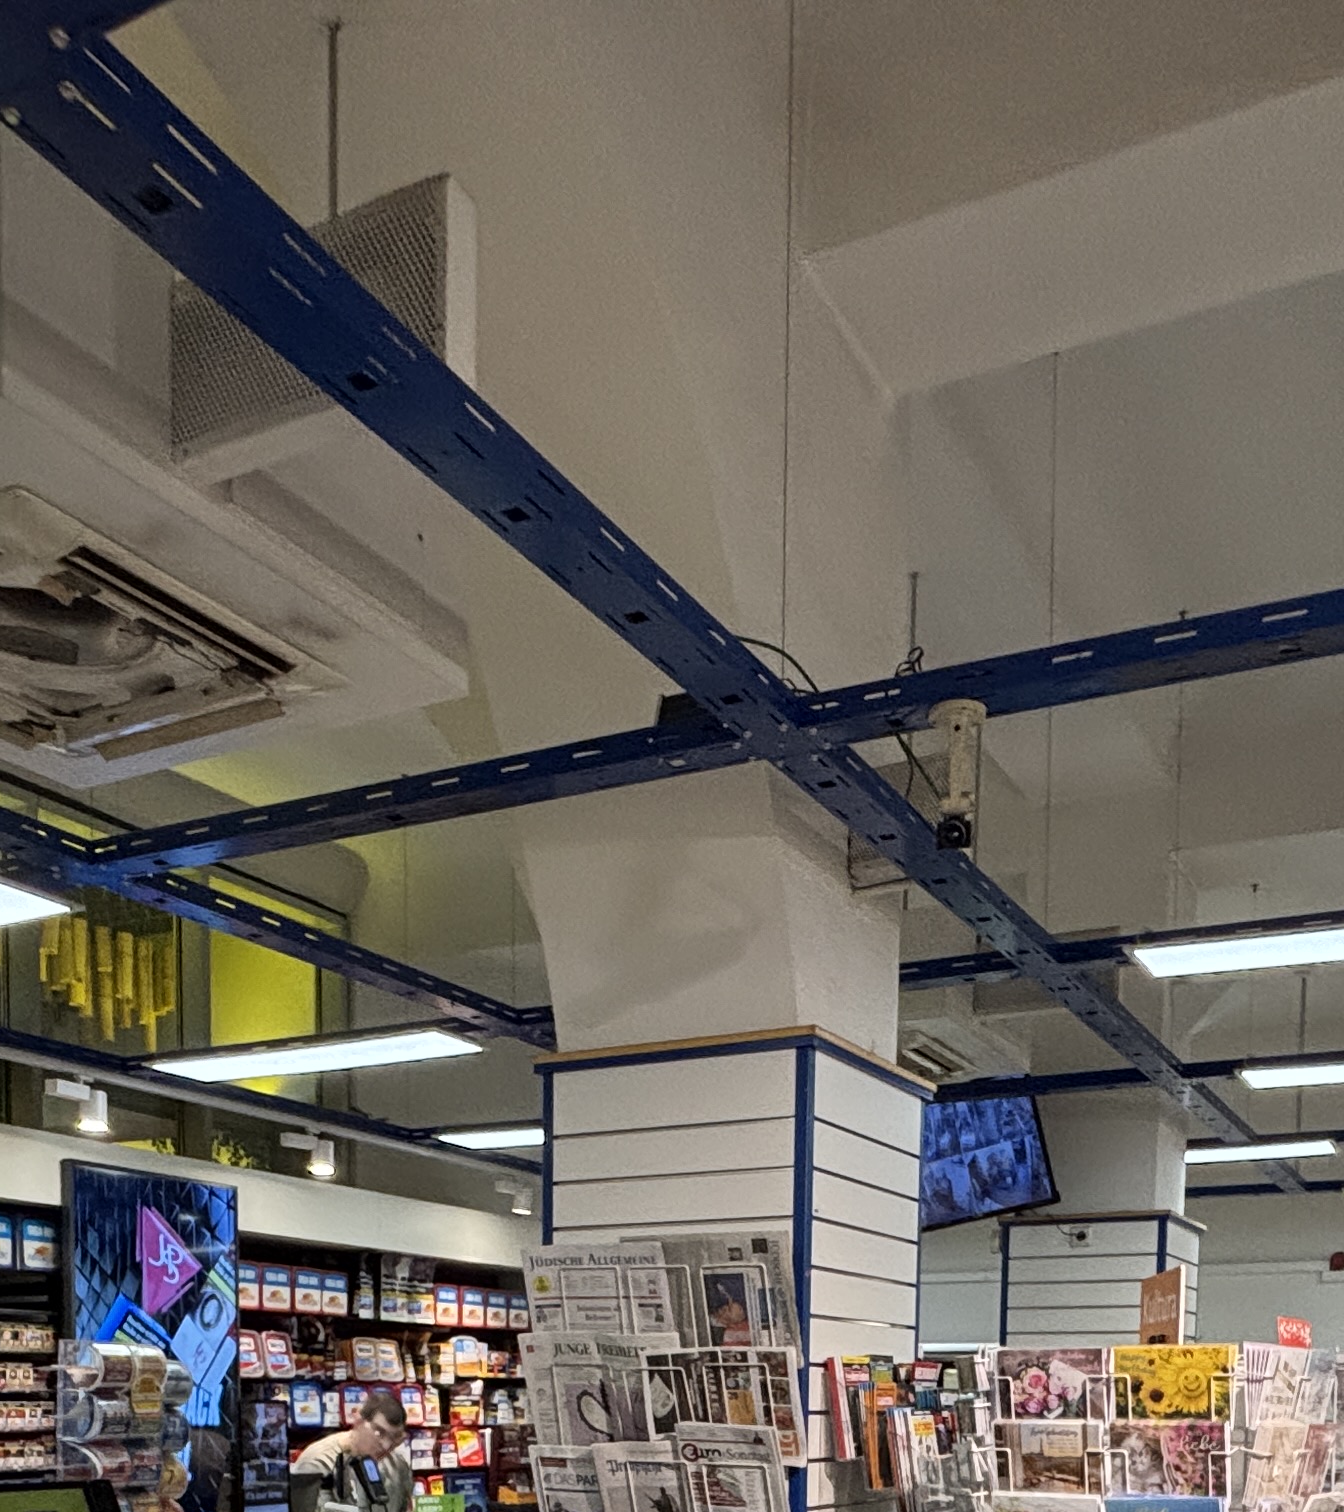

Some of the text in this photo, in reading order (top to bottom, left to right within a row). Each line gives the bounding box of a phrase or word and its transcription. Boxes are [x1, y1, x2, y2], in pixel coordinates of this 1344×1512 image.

[529, 1253, 657, 1270] JÜDISCHE ALLGEMEINE
[553, 1343, 592, 1357] JUNGE
